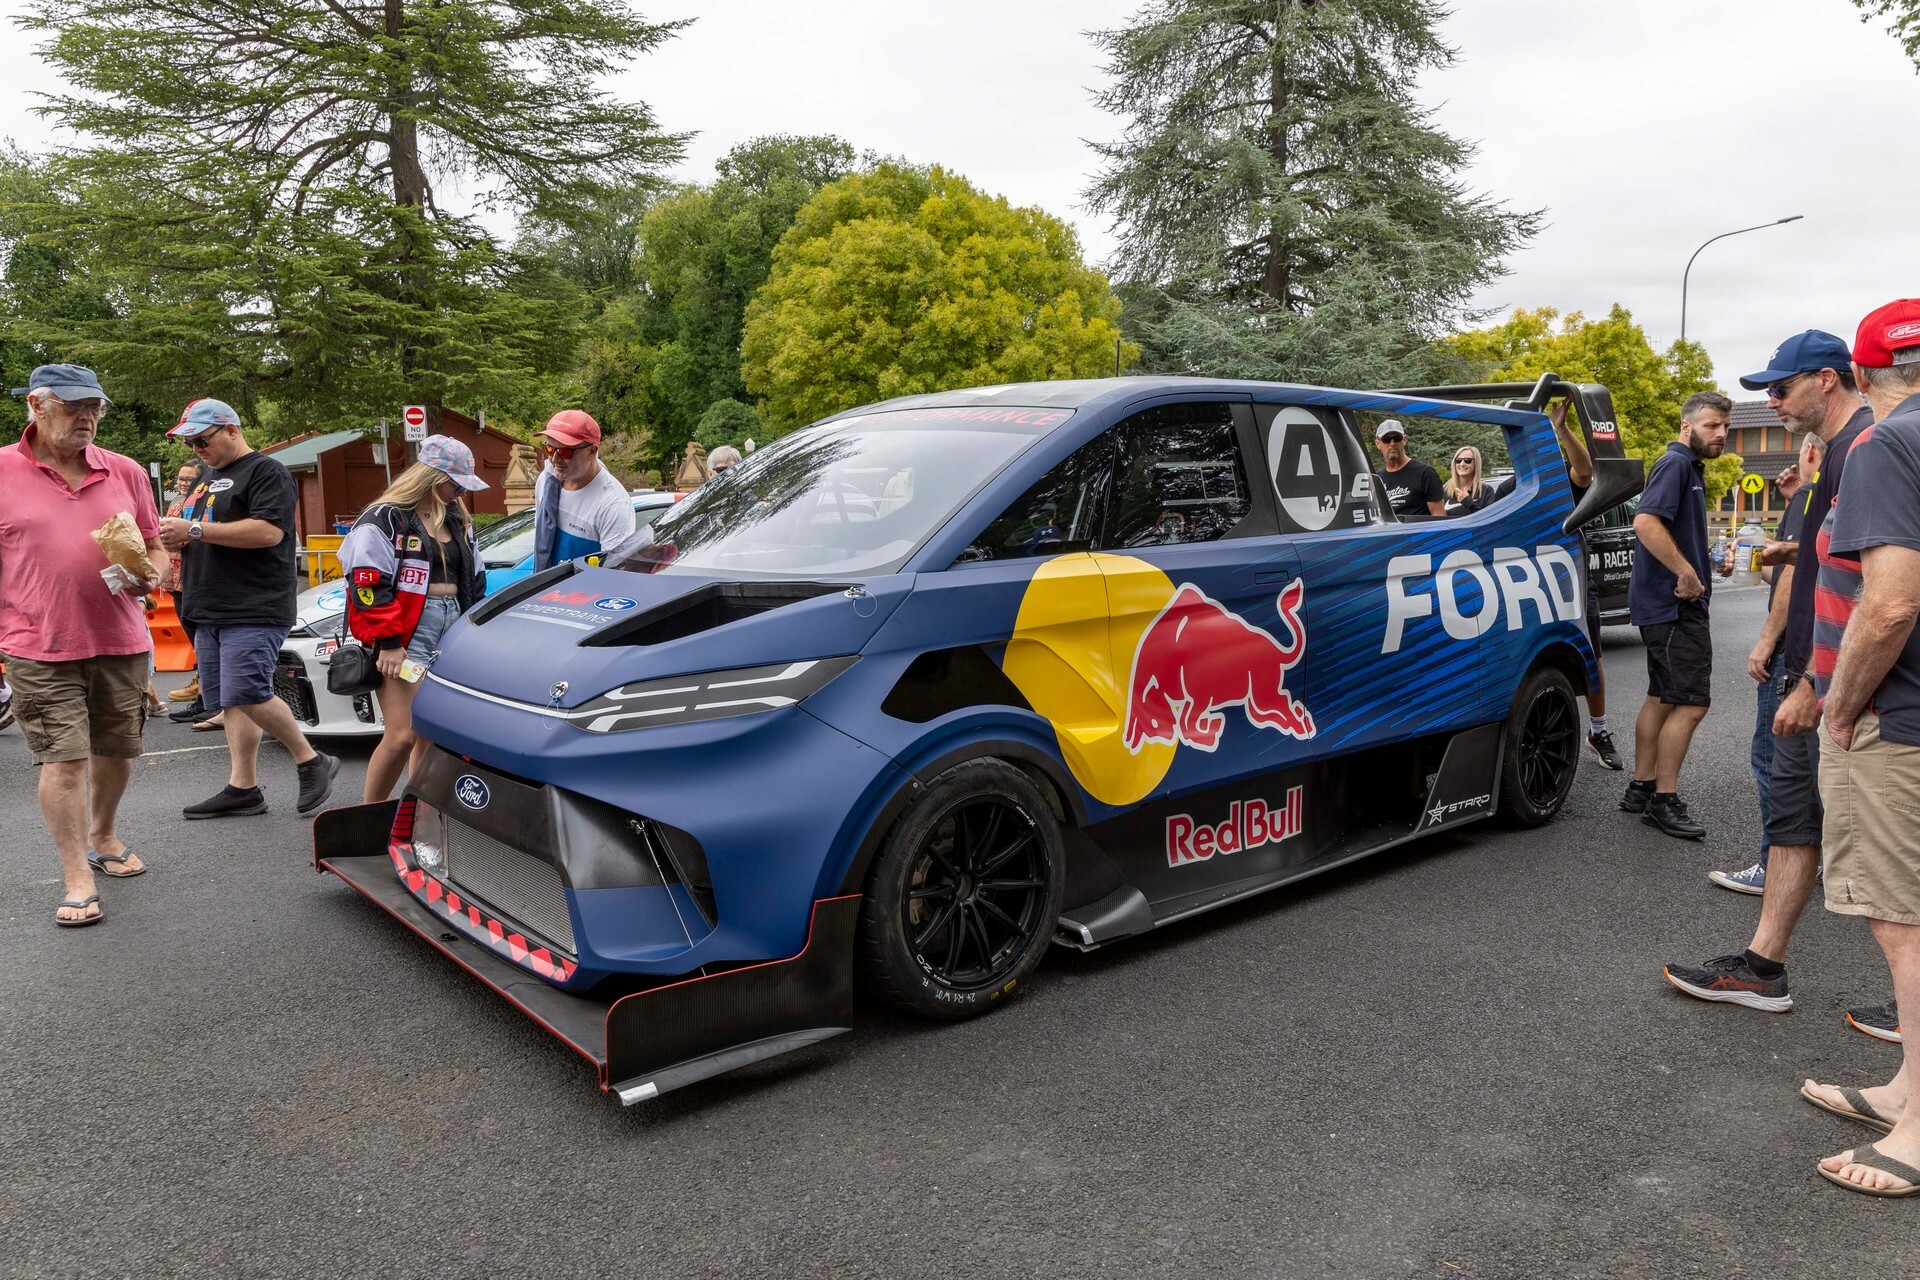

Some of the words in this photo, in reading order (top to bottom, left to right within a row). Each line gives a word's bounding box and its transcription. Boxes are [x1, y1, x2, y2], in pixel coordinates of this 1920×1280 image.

[1591, 420, 1615, 433] FORD
[1603, 550, 1628, 569] RACE
[360, 572, 373, 582] F-1
[600, 598, 632, 610] Ford
[1381, 545, 1582, 655] FORD
[519, 603, 613, 624] POWERTRAINS
[460, 778, 484, 806] Ford
[1448, 794, 1491, 813] STARD
[1166, 800, 1242, 868] Red
[1244, 784, 1303, 850] Bull
